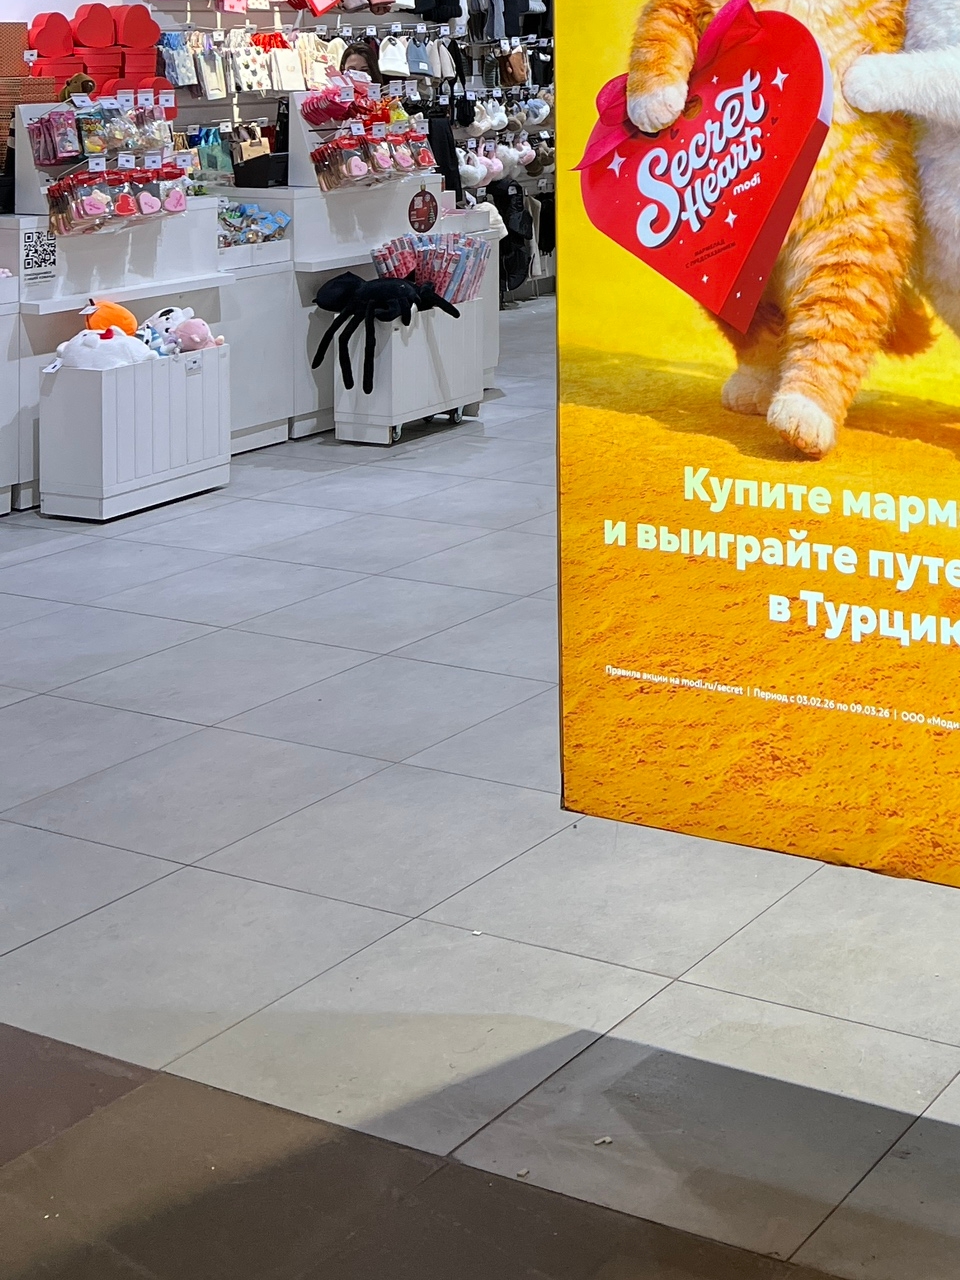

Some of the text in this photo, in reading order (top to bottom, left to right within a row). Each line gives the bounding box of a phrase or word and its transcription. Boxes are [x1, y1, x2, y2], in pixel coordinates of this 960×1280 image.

[635, 68, 765, 248] Secret
[680, 126, 763, 233] Heart
[733, 172, 761, 196] modi
[683, 465, 831, 515] Купите
[603, 519, 627, 547] и
[636, 523, 858, 574] выиграйте
[768, 593, 791, 623] в
[605, 664, 641, 679] Правила
[642, 671, 668, 684] акции
[669, 676, 680, 685] на
[681, 677, 743, 696] modi.ru/secret
[753, 688, 788, 704] Период
[789, 695, 796, 703] с
[796, 694, 835, 710] 03.02.26
[836, 701, 849, 712] по
[849, 702, 890, 718] 09.03.26
[901, 711, 925, 724] ООО
